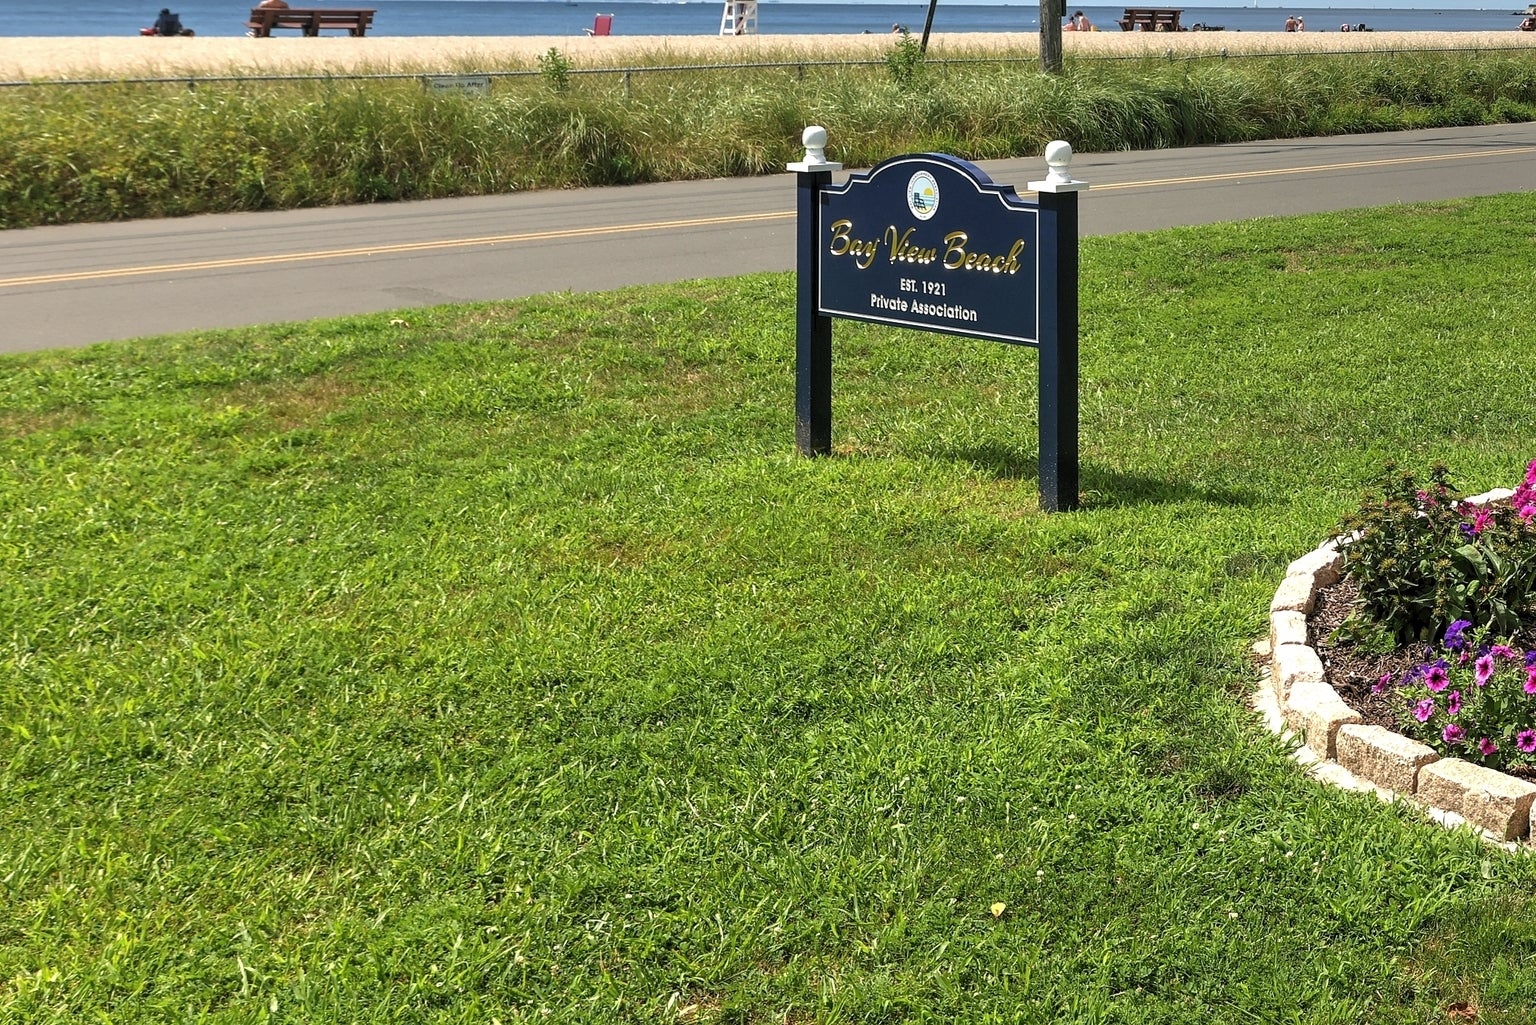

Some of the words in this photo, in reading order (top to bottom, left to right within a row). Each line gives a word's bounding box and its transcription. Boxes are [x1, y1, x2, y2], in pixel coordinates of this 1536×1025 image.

[830, 219, 881, 270] Bay
[884, 225, 938, 264] View
[942, 230, 1026, 275] Beach
[900, 278, 918, 293] EST.
[922, 280, 947, 296] 1921
[870, 293, 908, 313] Private
[911, 299, 978, 322] Association
